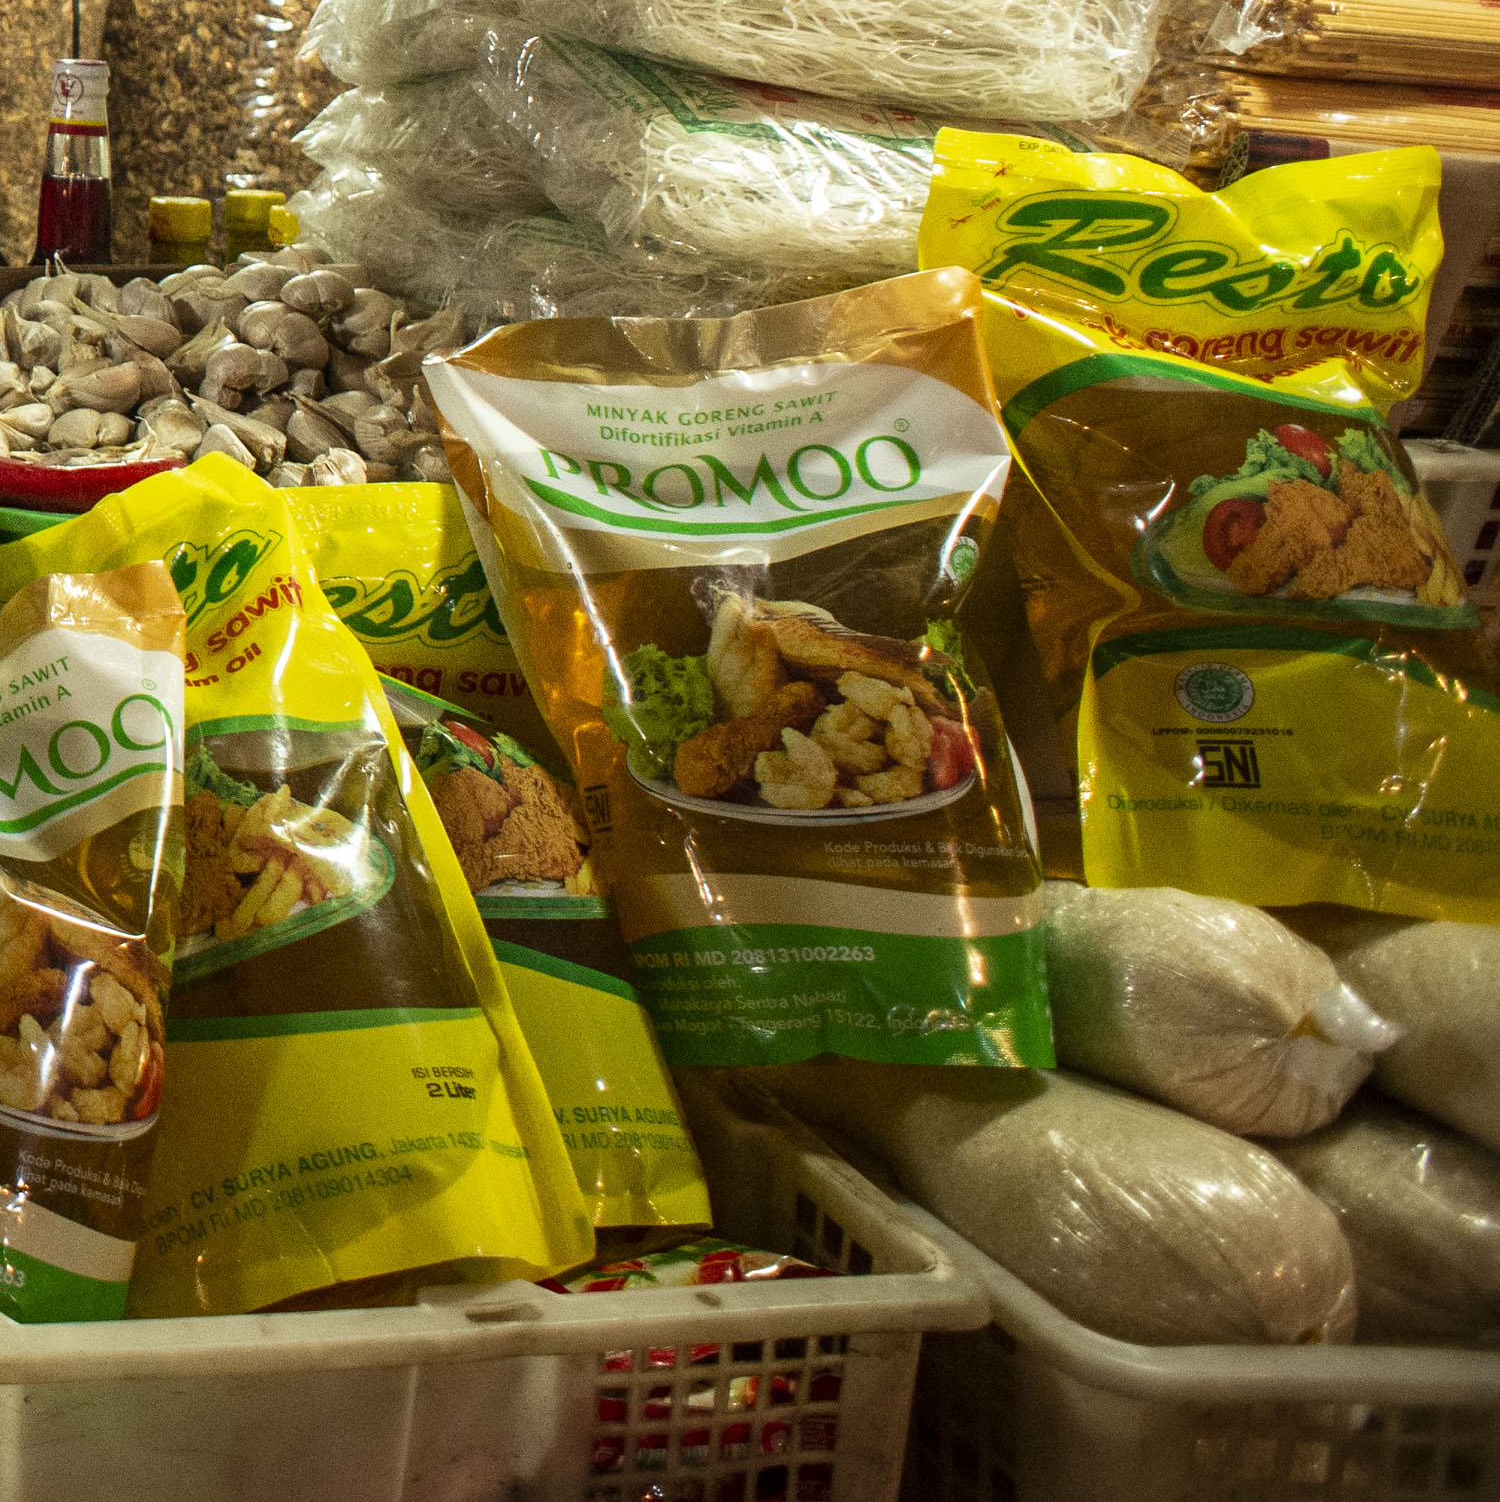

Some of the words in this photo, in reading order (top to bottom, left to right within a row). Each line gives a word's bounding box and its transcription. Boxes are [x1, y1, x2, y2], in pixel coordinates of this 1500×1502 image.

[978, 196, 1420, 312] Resto
[1298, 323, 1424, 362] sawit
[586, 402, 668, 426] MINYAK
[677, 401, 766, 428] GORENG
[773, 390, 838, 415] SAWIT
[599, 422, 721, 449] Difortifikasi
[728, 412, 804, 439] Vitamin
[808, 409, 826, 426] A
[538, 433, 924, 516] PROMOO
[206, 571, 304, 655] sawit
[8, 654, 72, 693] SAWIT
[56, 684, 74, 702] A
[1200, 741, 1261, 788] SNI
[824, 840, 862, 854] Kode
[864, 840, 923, 855] Produksi
[866, 855, 899, 872] pada
[694, 950, 726, 968] MD
[426, 1082, 442, 1098] 2
[444, 1081, 477, 1100] Liter
[572, 1105, 634, 1124] SURYA
[220, 1161, 292, 1197] SURYA
